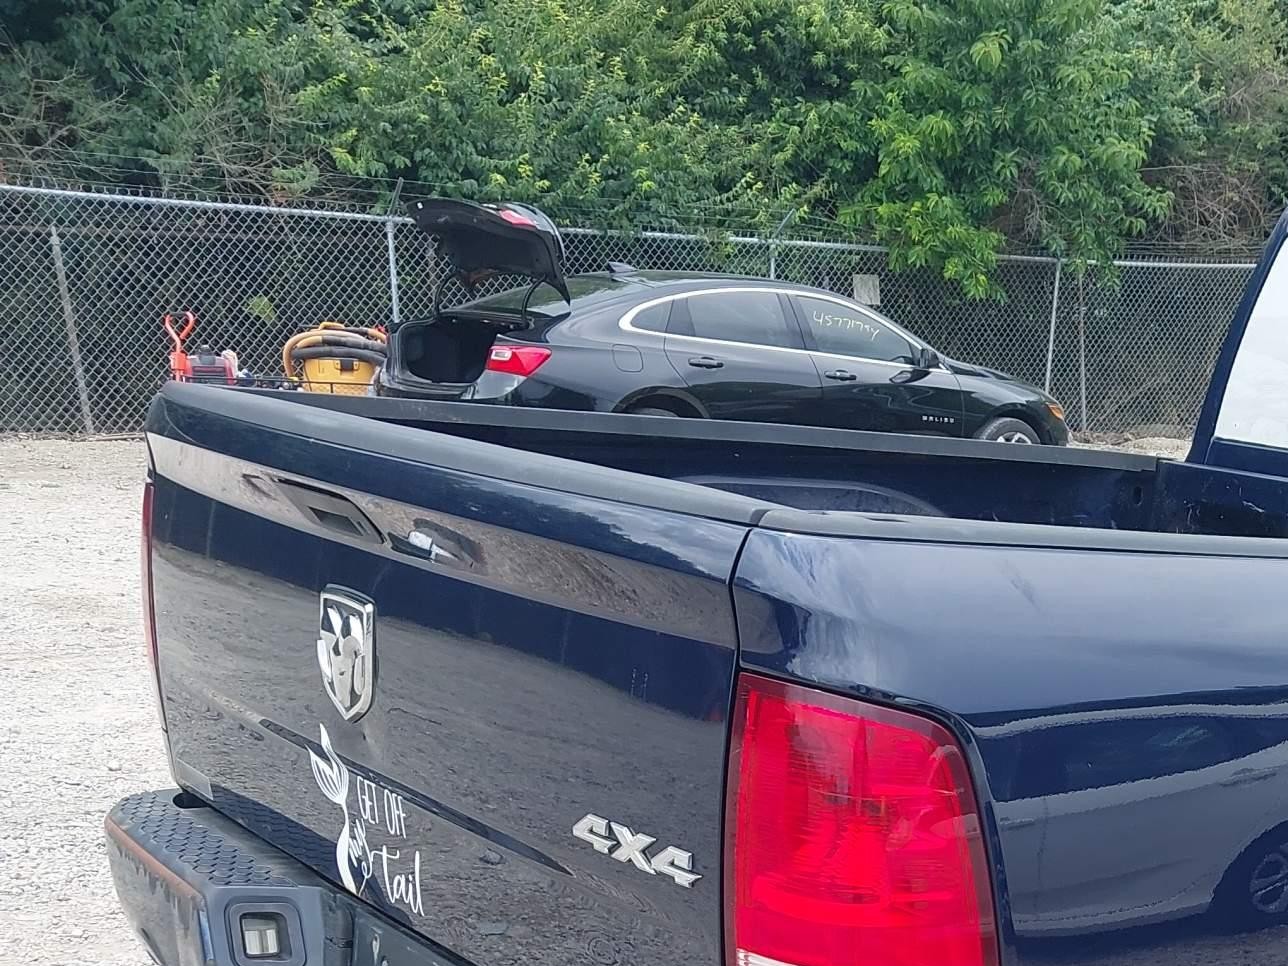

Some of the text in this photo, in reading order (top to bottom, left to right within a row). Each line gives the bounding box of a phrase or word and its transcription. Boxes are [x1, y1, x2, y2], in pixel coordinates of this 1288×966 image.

[356, 775, 407, 839] GET OFF
[374, 845, 425, 917] tail
